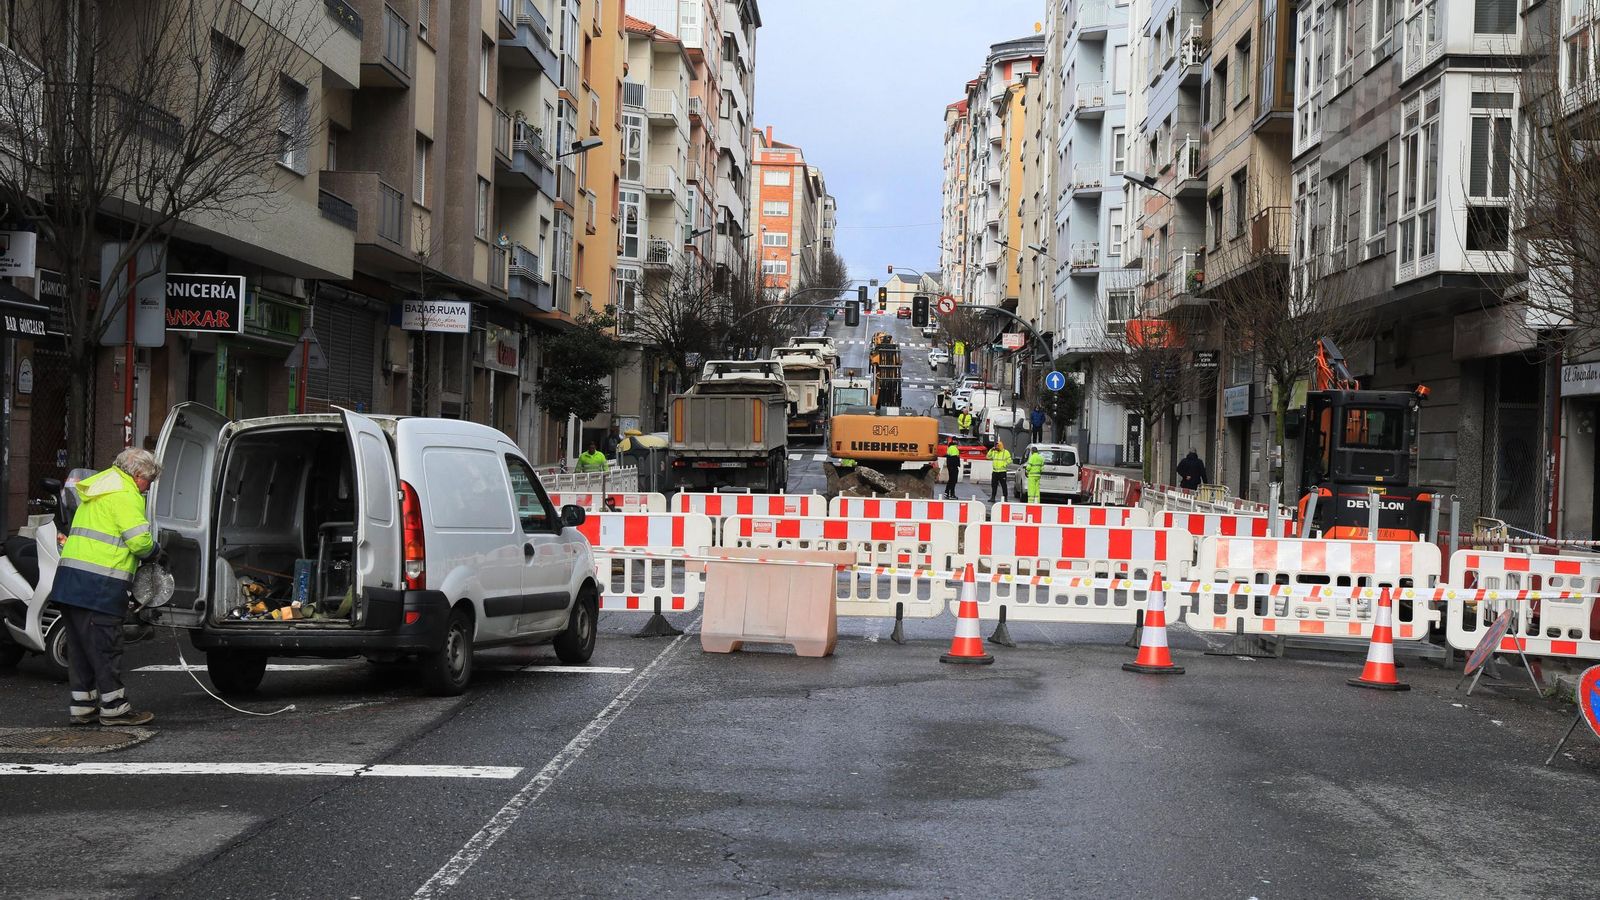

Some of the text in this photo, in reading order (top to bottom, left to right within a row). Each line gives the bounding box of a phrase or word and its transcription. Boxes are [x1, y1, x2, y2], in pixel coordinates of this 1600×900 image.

[405, 304, 467, 315] BAZAR RUAYA
[4, 315, 46, 336] BAR GONZALEZ
[872, 425, 899, 436] 914
[851, 441, 918, 453] LIEBHERR
